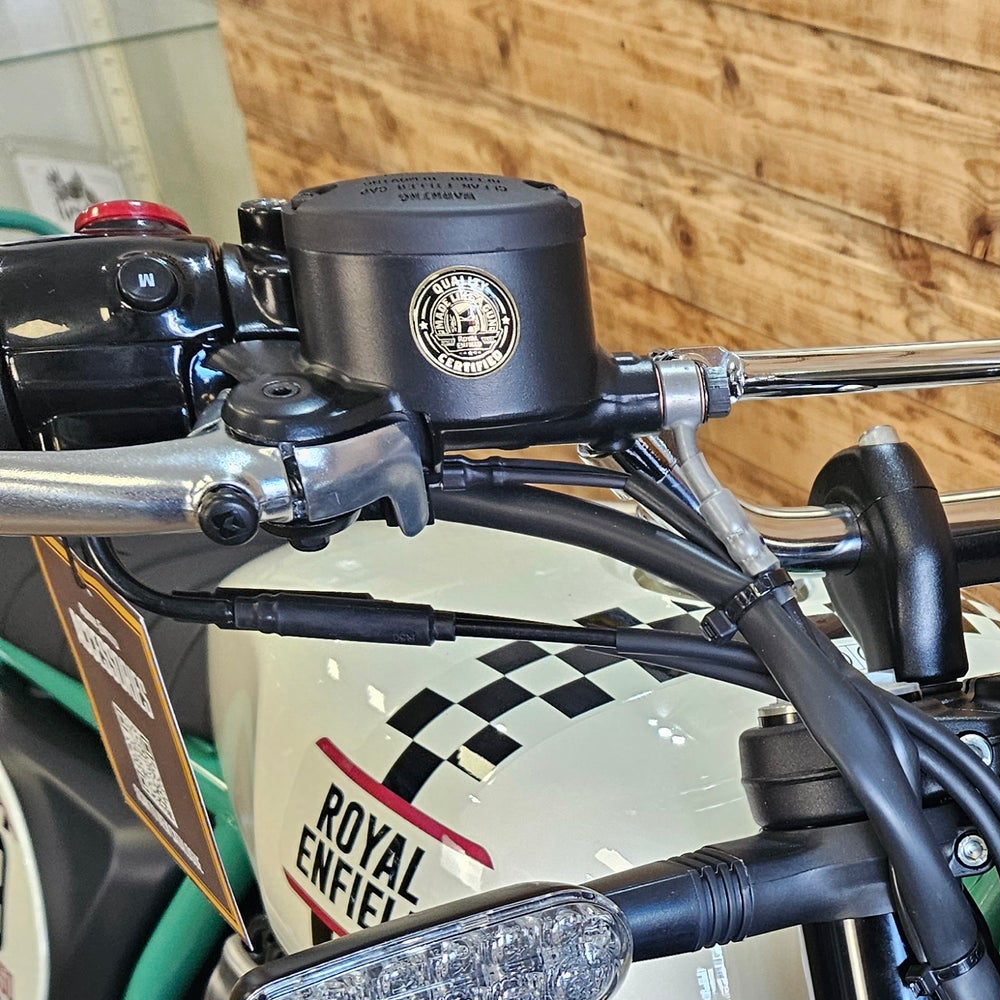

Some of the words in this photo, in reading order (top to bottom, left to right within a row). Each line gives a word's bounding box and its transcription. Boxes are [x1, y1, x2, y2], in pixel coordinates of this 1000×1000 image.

[432, 275, 490, 295] QUALITY
[437, 349, 504, 373] CERTIFIED
[316, 782, 426, 906] ROYAL
